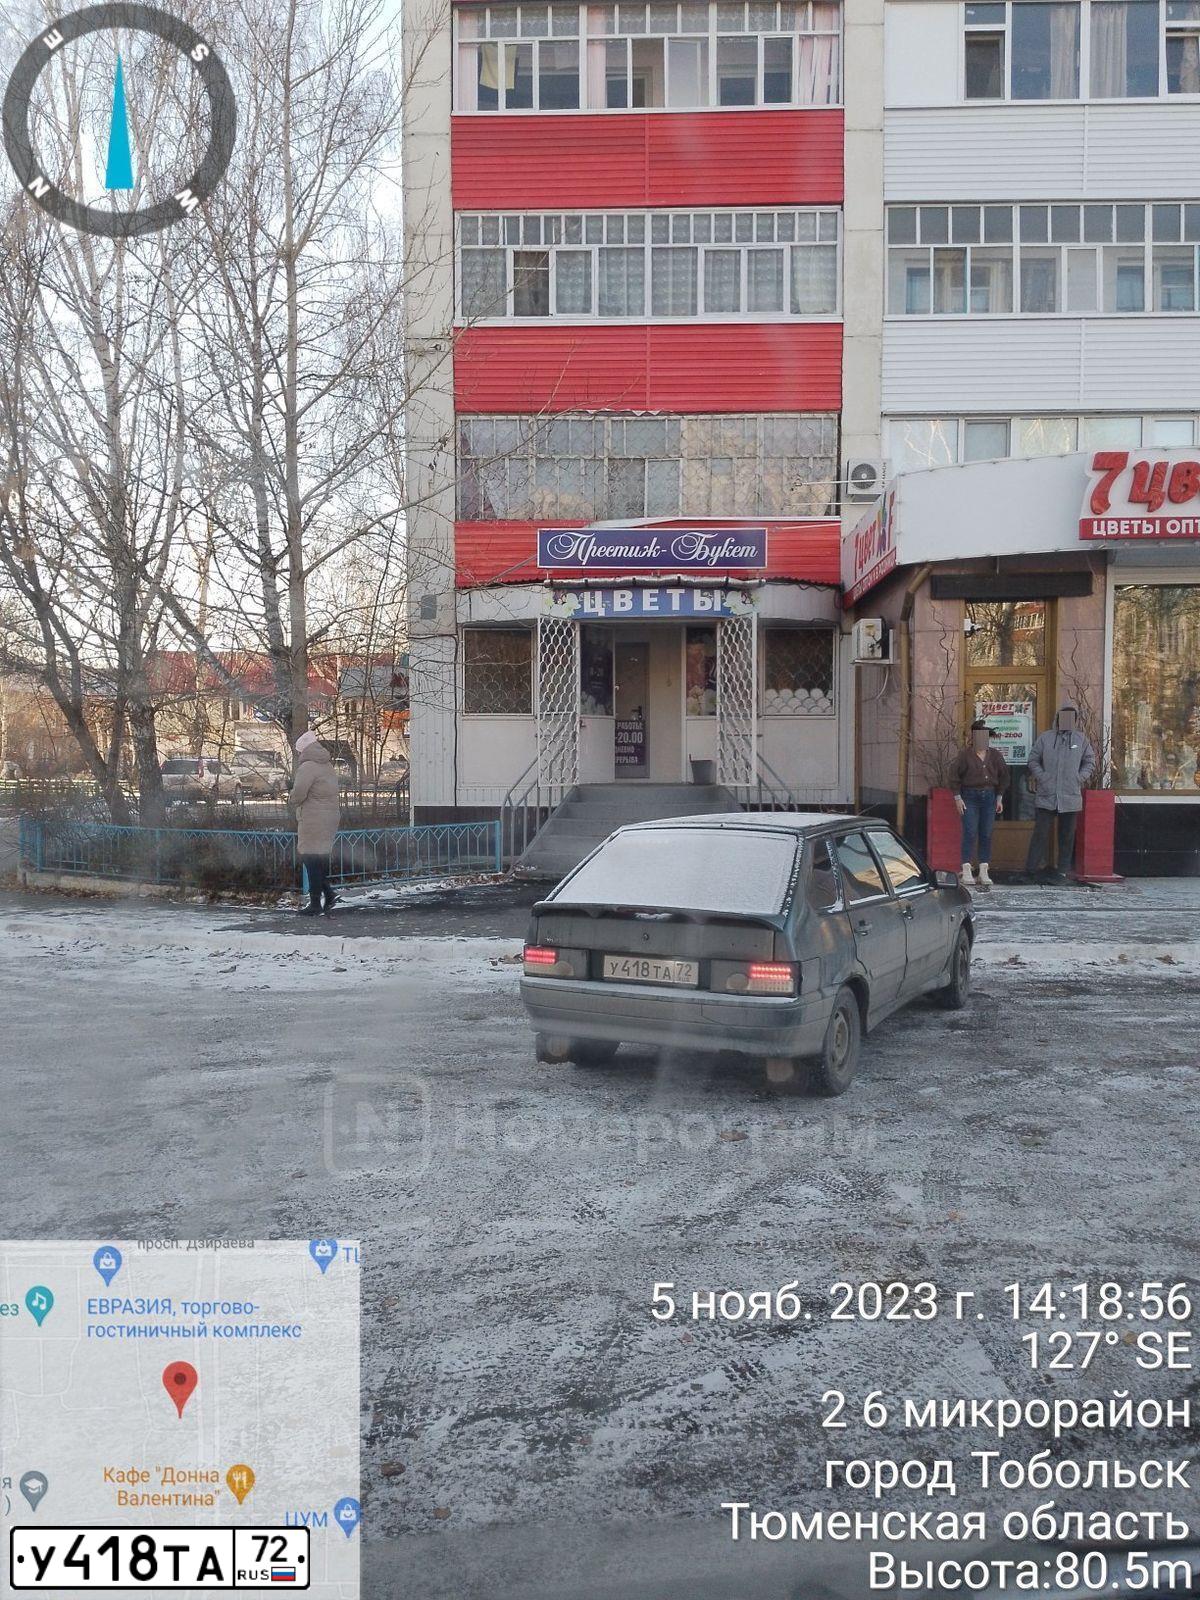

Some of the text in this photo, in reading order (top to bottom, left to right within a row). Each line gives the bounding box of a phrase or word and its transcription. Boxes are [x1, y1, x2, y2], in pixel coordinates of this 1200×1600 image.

[1092, 519, 1160, 536] ЦВЕТЫ
[583, 588, 721, 616] ЦВЕТЫ
[610, 960, 692, 980] У418ТА 72
